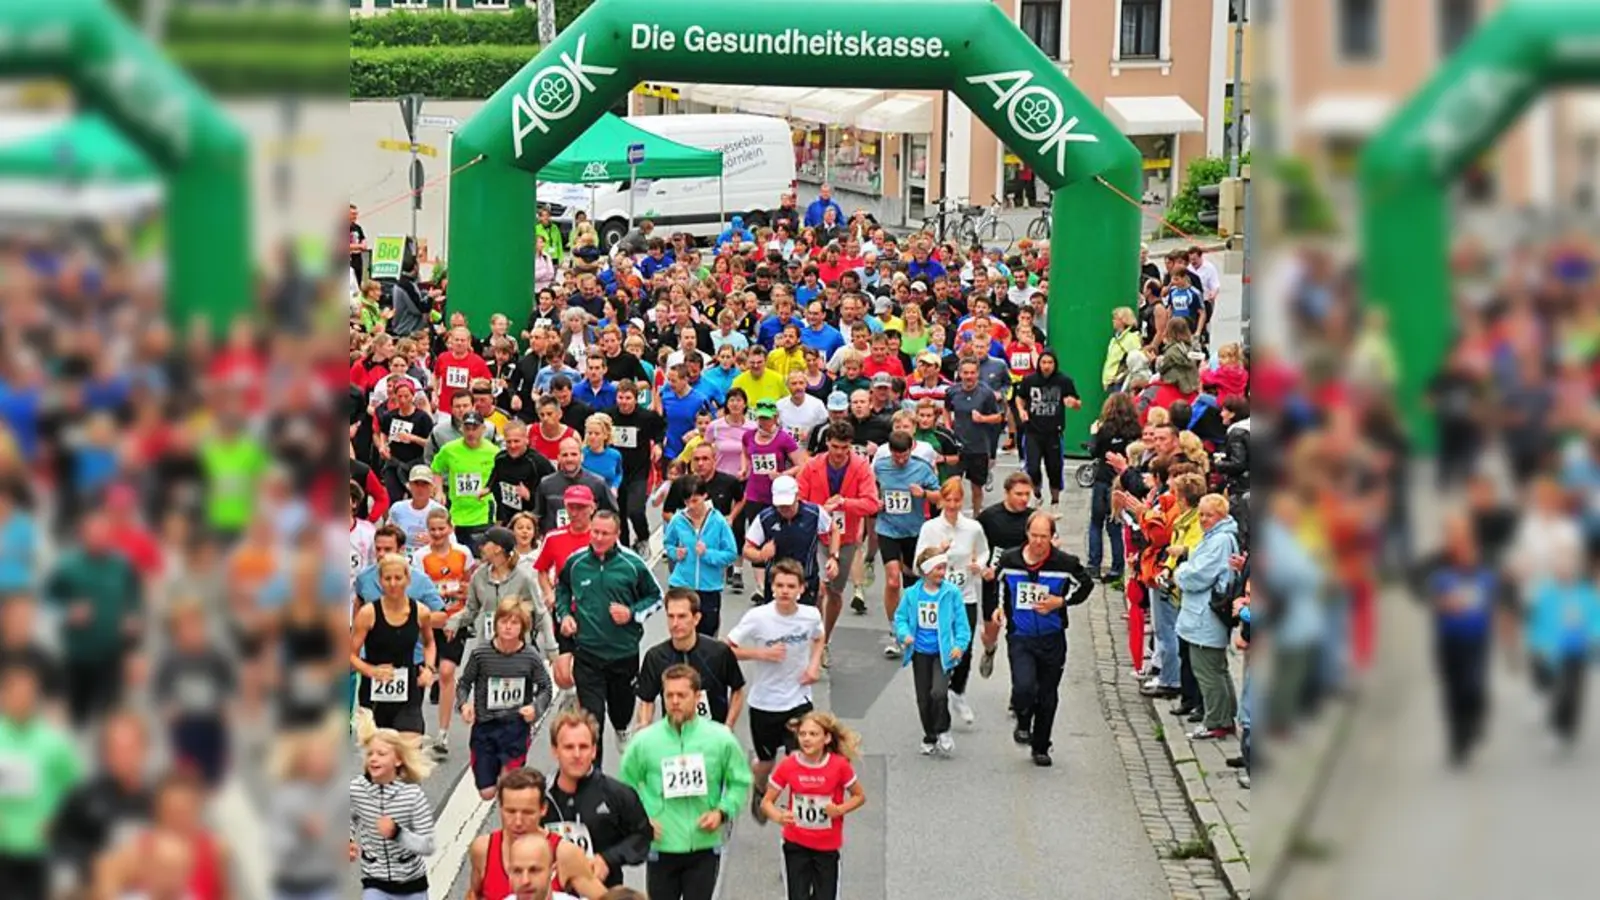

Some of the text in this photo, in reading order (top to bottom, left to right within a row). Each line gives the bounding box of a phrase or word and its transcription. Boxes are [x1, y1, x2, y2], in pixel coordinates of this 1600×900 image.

[631, 23, 951, 58] Die Gesundheitskasse.
[511, 32, 618, 159] AOK
[964, 69, 1099, 177] AOK
[581, 160, 609, 177] AOK
[378, 242, 401, 259] Bio
[754, 460, 776, 470] 345
[457, 479, 481, 492] 387
[886, 497, 910, 510] 317
[920, 610, 937, 625] 10
[374, 681, 406, 696] 268
[493, 687, 522, 702] 100
[666, 769, 703, 789] 288
[797, 805, 829, 823] 105
